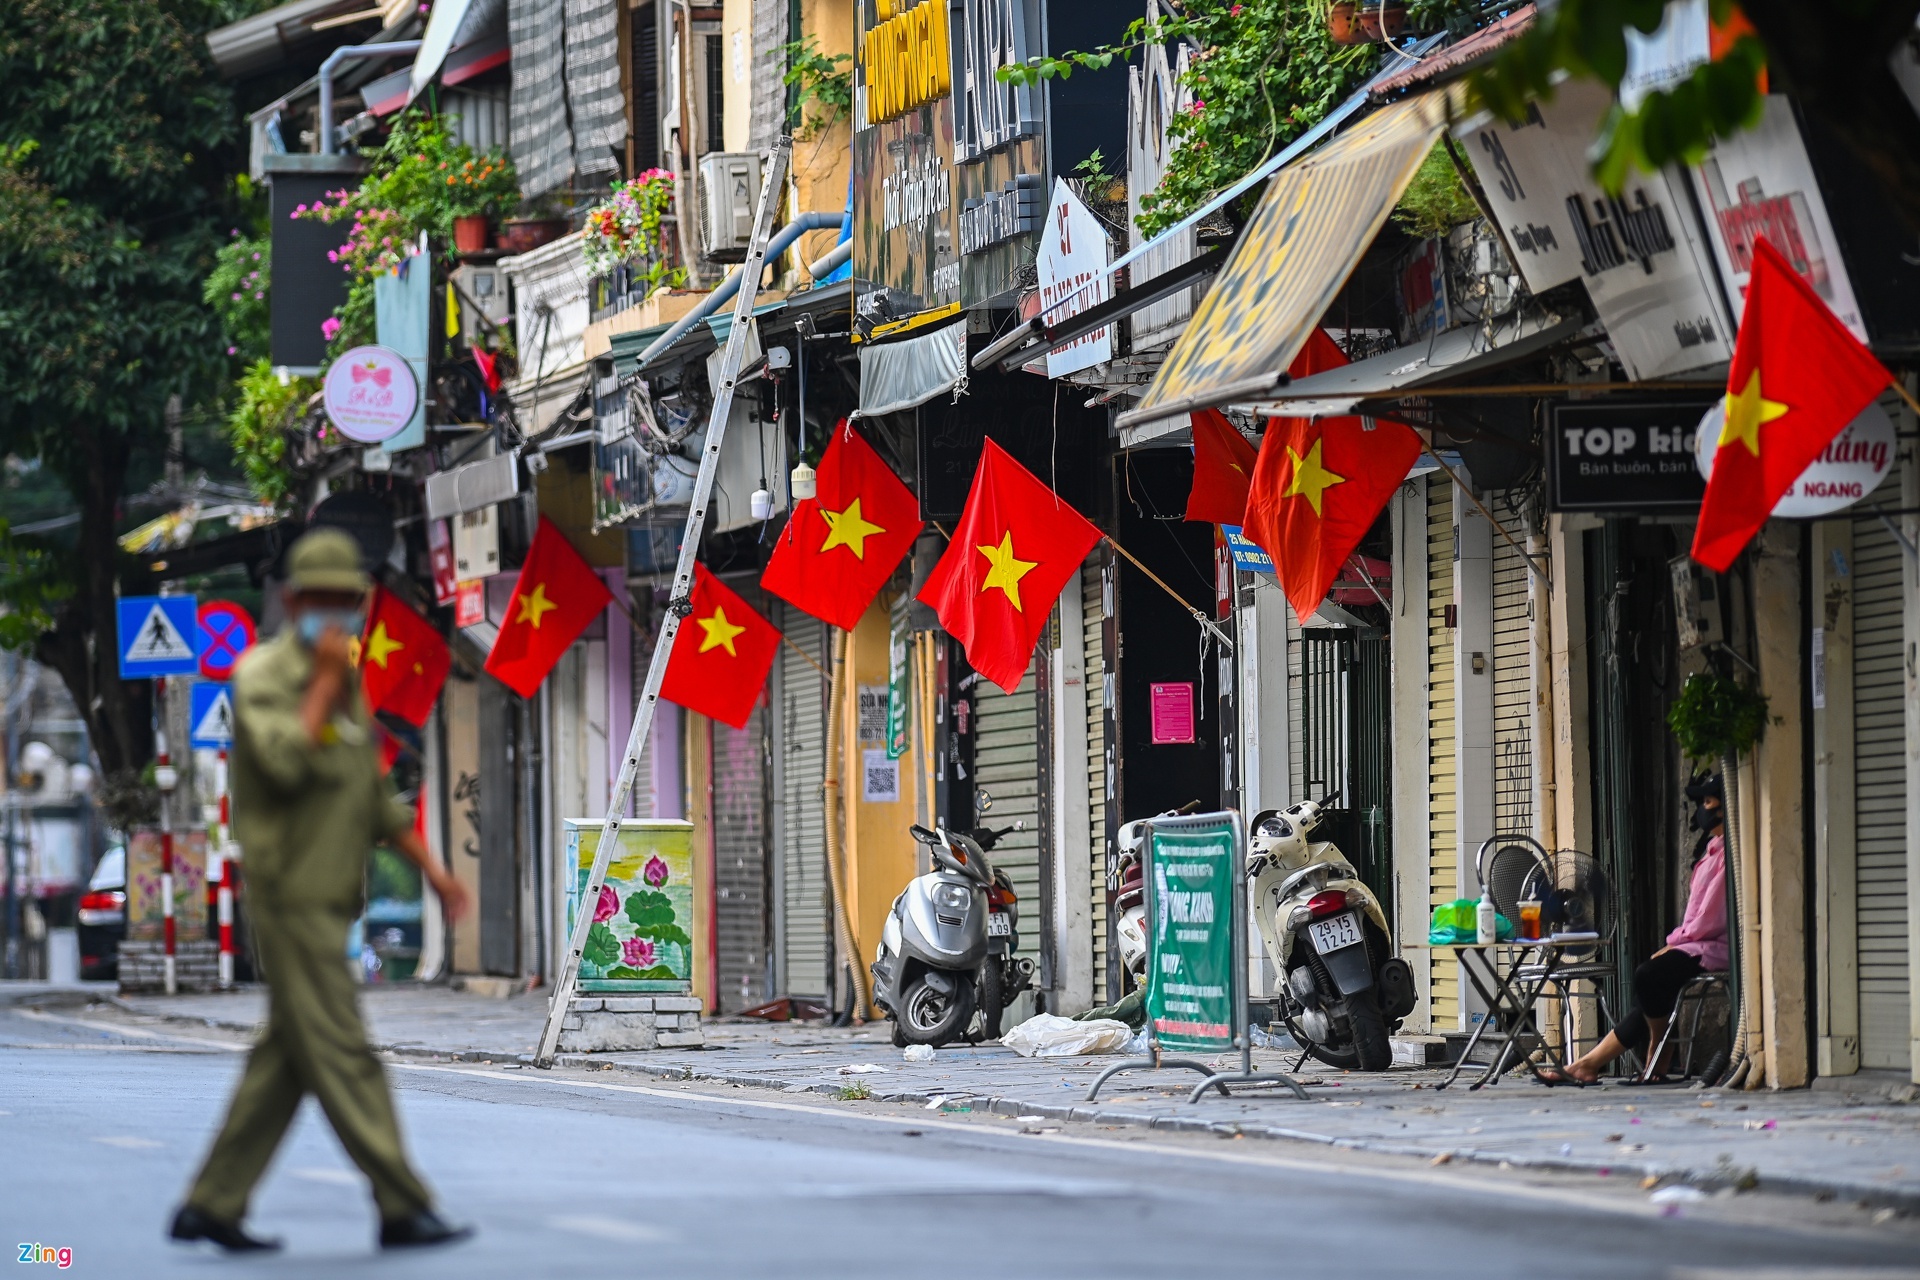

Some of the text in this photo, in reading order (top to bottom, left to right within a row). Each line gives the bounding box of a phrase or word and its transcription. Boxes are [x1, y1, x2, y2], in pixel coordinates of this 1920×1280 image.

[901, 169, 924, 232] Trang
[936, 156, 950, 212] Em
[1565, 427, 1637, 456] TOP
[1579, 461, 1609, 476] Bán
[1659, 460, 1688, 475] bán
[1804, 482, 1863, 499] NGANG
[1229, 533, 1239, 545] 25
[1190, 891, 1214, 923] XANH
[1316, 915, 1351, 938] 29-Y5
[1322, 928, 1357, 950] 1242
